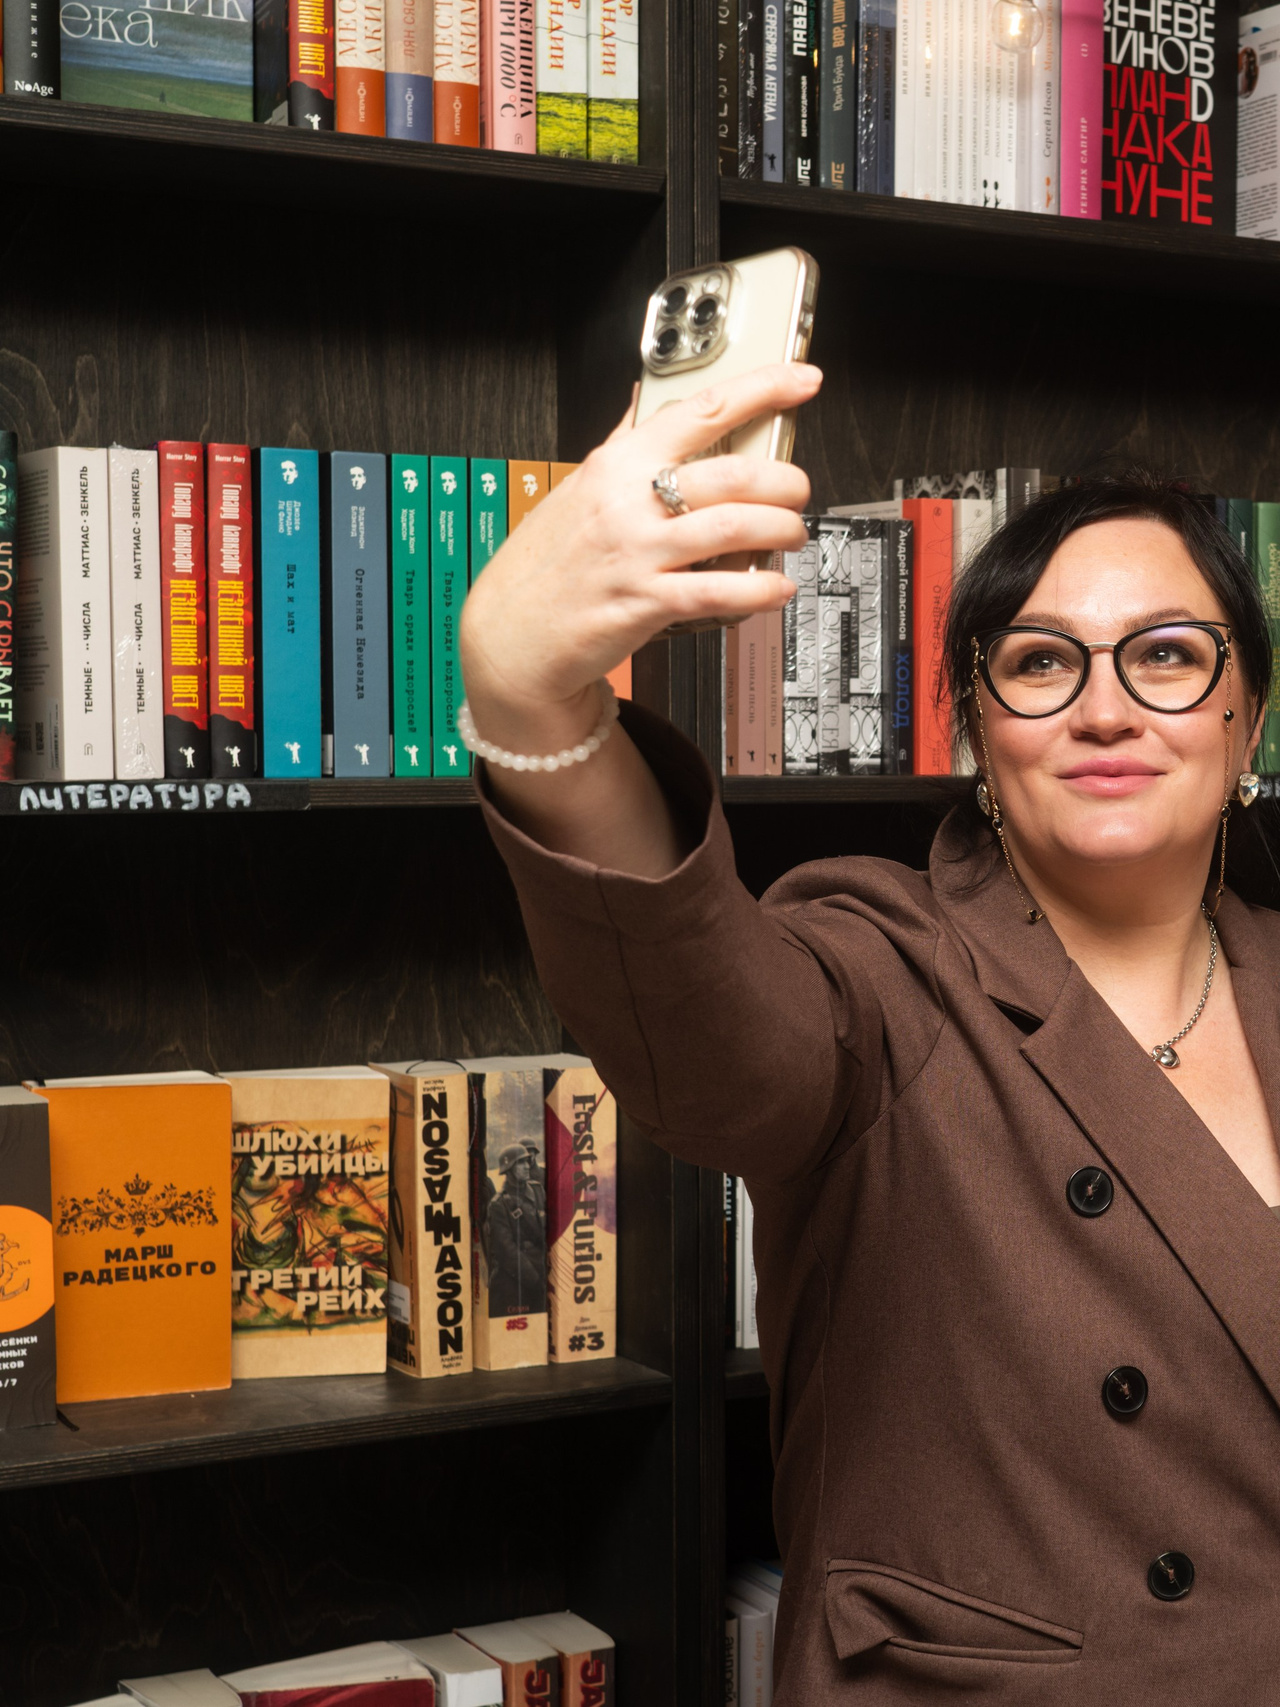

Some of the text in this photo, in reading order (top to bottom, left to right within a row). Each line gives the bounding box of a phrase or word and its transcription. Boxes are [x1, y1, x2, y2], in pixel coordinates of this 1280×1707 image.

[403, 30, 415, 57] ЛЯН
[832, 24, 847, 48] ВОР,
[298, 42, 326, 79] ЦВЕТ
[500, 42, 517, 89] 1000
[764, 5, 778, 121] СЕРЕБРЯНАЯ ЛЕГЕНДА
[901, 18, 909, 95] ИВАН ШЕСТАКОВ
[832, 55, 844, 111] Юрий Буйда
[1043, 81, 1052, 115] Носов
[358, 82, 366, 122] ГИПЕРИОН
[405, 88, 414, 127] ГИПЕРИОН
[453, 96, 462, 135] ГИПЕРИОН
[1043, 119, 1053, 157] Сергей
[166, 452, 198, 461] Horror Story
[215, 454, 246, 465] Horror Story
[79, 466, 94, 714] ТЕМНЫЕ ЧИСЛА МАТТИАС ЗЕНКЕЛЬ
[131, 468, 146, 714] ТЕМНЫЕ ЧИСЛА МАТТИАС ЗЕНКЕЛЬ
[286, 563, 297, 589] Шах
[169, 482, 201, 709] Говард Лавкрафт НЕЗДЕШНИЙ ЦВЕТ
[217, 484, 248, 709] Говард Лавкрафт НЕЗДЕШНИЙ ЦВЕТ
[286, 611, 296, 635] мат
[354, 568, 367, 701] Огненная Немезида
[892, 529, 910, 729] Андрей Геласимов ХОЛОД
[404, 569, 417, 734] Тварь среди водорослей
[444, 571, 456, 734] Тварь среди водорослей
[748, 642, 756, 724] КОЗЛИНАЯ ПЕСНЬ
[769, 646, 777, 727] КОЗЛИНАЯ ПЕСНЬ
[19, 783, 253, 811] ЛИТЕРАТУРА
[232, 1130, 342, 1153] ШЛЮХИ
[252, 1149, 389, 1176] УБИЙЦЫ
[572, 1171, 598, 1194] &
[104, 1244, 174, 1264] МАРШ
[63, 1260, 217, 1287] РАДЕЦКОГО
[232, 1256, 362, 1291] ТРЕТИЙ
[297, 1285, 386, 1312] РЕЙХ
[505, 1317, 529, 1330] #5
[568, 1331, 605, 1352] #3
